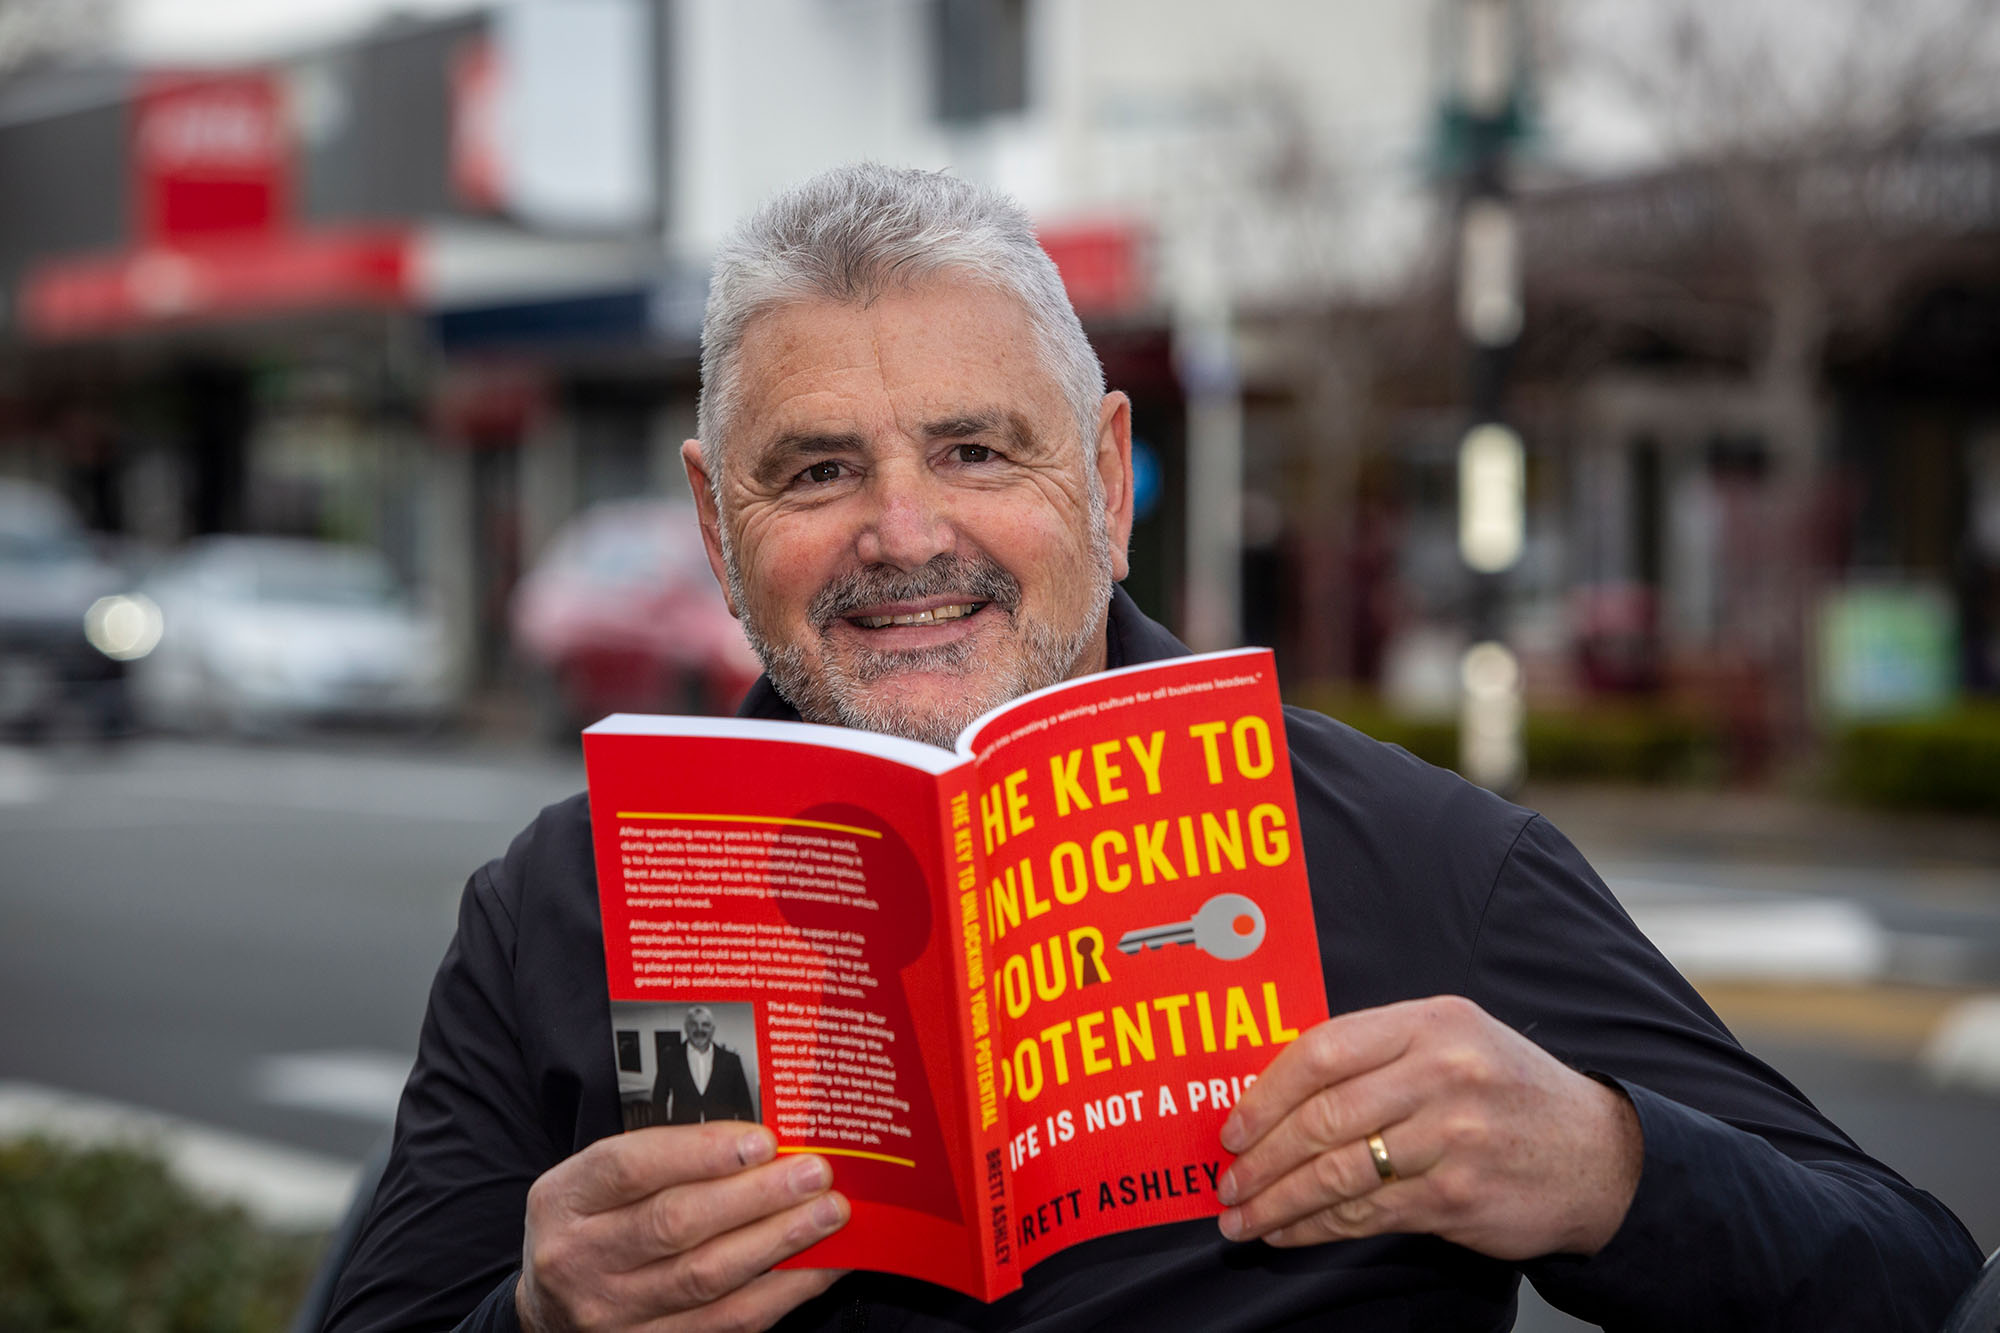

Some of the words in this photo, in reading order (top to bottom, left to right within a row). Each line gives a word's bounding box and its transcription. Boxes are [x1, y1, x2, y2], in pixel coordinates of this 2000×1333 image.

[980, 768, 1035, 856] HE
[1049, 730, 1166, 818] KEY
[1189, 715, 1275, 786] TO
[951, 790, 970, 829] THE
[619, 826, 644, 837] After
[646, 827, 693, 840] spending
[693, 830, 722, 841] many
[724, 831, 751, 841] years
[763, 831, 780, 842] the
[781, 834, 829, 847] corporate
[830, 838, 859, 853] world,
[954, 827, 974, 863] KEY
[621, 840, 654, 853] during
[656, 842, 685, 852] which
[686, 842, 708, 853] time
[709, 842, 723, 853] he
[724, 844, 765, 855] became
[767, 848, 798, 858] aware
[798, 848, 810, 859] of
[810, 849, 831, 860] how
[832, 852, 854, 867] easy
[623, 867, 649, 879] Brett
[650, 868, 682, 882] Ashley
[694, 870, 720, 881] clear
[720, 870, 743, 882] that
[744, 872, 762, 883] the
[763, 874, 787, 885] most
[788, 874, 836, 889] important
[836, 880, 867, 895] lesson
[632, 855, 644, 865] to
[644, 854, 686, 866] become
[687, 856, 729, 869] trapped
[740, 859, 755, 869] an
[756, 860, 815, 876] unsatisfying
[816, 865, 867, 882] workplace,
[958, 864, 976, 892] TO
[624, 882, 639, 893] he
[640, 882, 680, 894] learned
[680, 884, 722, 895] involved
[723, 886, 766, 899] creating
[766, 888, 781, 898] an
[781, 888, 841, 904] environment
[852, 897, 879, 911] which
[626, 898, 673, 909] everyone
[674, 897, 713, 909] thrived.
[629, 918, 675, 933] Although
[676, 920, 689, 931] he
[690, 920, 720, 932] didn't
[721, 920, 756, 935] always
[757, 922, 782, 935] have
[783, 924, 801, 936] the
[802, 928, 839, 940] support
[840, 930, 851, 942] of
[850, 932, 866, 945] his
[960, 890, 986, 990] UNLOCKING
[630, 934, 685, 946] employers,
[685, 934, 699, 945] he
[700, 936, 757, 947] persevered
[758, 938, 778, 948] and
[778, 938, 811, 951] before
[811, 940, 834, 955] long
[834, 944, 863, 958] senior
[632, 949, 700, 961] management
[700, 949, 730, 960] could
[730, 951, 749, 961] see
[750, 950, 771, 962] that
[772, 951, 790, 963] the
[791, 954, 839, 968] structures
[838, 957, 852, 970] he
[852, 961, 870, 973] put
[632, 960, 644, 973] in
[644, 960, 673, 975] place
[674, 963, 692, 973] not
[693, 962, 715, 976] only
[716, 962, 757, 976] brought
[757, 965, 806, 978] increased
[806, 968, 840, 983] profits,
[840, 972, 857, 984] but
[858, 974, 879, 988] also
[634, 976, 672, 989] greater
[672, 976, 691, 990] job
[692, 976, 751, 989] satisfaction
[750, 977, 765, 989] for
[766, 980, 812, 993] everyone
[822, 983, 837, 995] his
[838, 986, 867, 999] team,
[994, 926, 1112, 1031] OUR
[766, 1000, 786, 1013] The
[786, 1002, 805, 1016] Key
[806, 1005, 818, 1015] to
[818, 1004, 865, 1023] Unlocking
[866, 1011, 887, 1025] Your
[970, 988, 990, 1039] YOUR
[768, 1015, 812, 1028] Potential
[814, 1018, 840, 1031] takes
[848, 1024, 896, 1042] refreshing
[769, 1030, 818, 1042] approach
[818, 1033, 830, 1044] to
[830, 1034, 866, 1051] making
[866, 1039, 884, 1052] the
[770, 1044, 795, 1055] most
[796, 1044, 808, 1055] of
[809, 1047, 836, 1060] every
[836, 1048, 856, 1062] day
[856, 1051, 868, 1062] at
[868, 1054, 895, 1068] work,
[772, 1058, 821, 1072] especially
[822, 1060, 836, 1071] for
[837, 1062, 864, 1075] those
[773, 1071, 796, 1082] with
[796, 1072, 833, 1086] getting
[833, 1075, 850, 1086] the
[850, 1077, 872, 1090] best
[872, 1080, 895, 1094] from
[975, 1036, 999, 1132] POTENTIAL
[774, 1085, 798, 1095] their
[798, 1086, 829, 1099] team,
[842, 1090, 863, 1101] well
[876, 1095, 910, 1112] making
[776, 1098, 831, 1113] fascinating
[832, 1102, 852, 1114] and
[852, 1104, 893, 1120] valuable
[777, 1112, 817, 1125] reading
[817, 1113, 832, 1125] for
[832, 1116, 868, 1129] anyone
[869, 1120, 889, 1133] who
[890, 1122, 912, 1138] feels
[818, 1127, 839, 1139] into
[839, 1129, 862, 1142] their
[862, 1132, 881, 1145] job.
[1008, 1124, 1041, 1172] IFE
[1046, 1110, 1075, 1147] IS
[1084, 1090, 1144, 1133] NOT
[1158, 1085, 1178, 1117] A
[1187, 1074, 1257, 1112] PRI
[986, 1148, 1005, 1201] BRETT
[1016, 1189, 1082, 1249] RETT
[1099, 1162, 1219, 1212] ASHLEY
[992, 1204, 1010, 1267] ASHLEY
